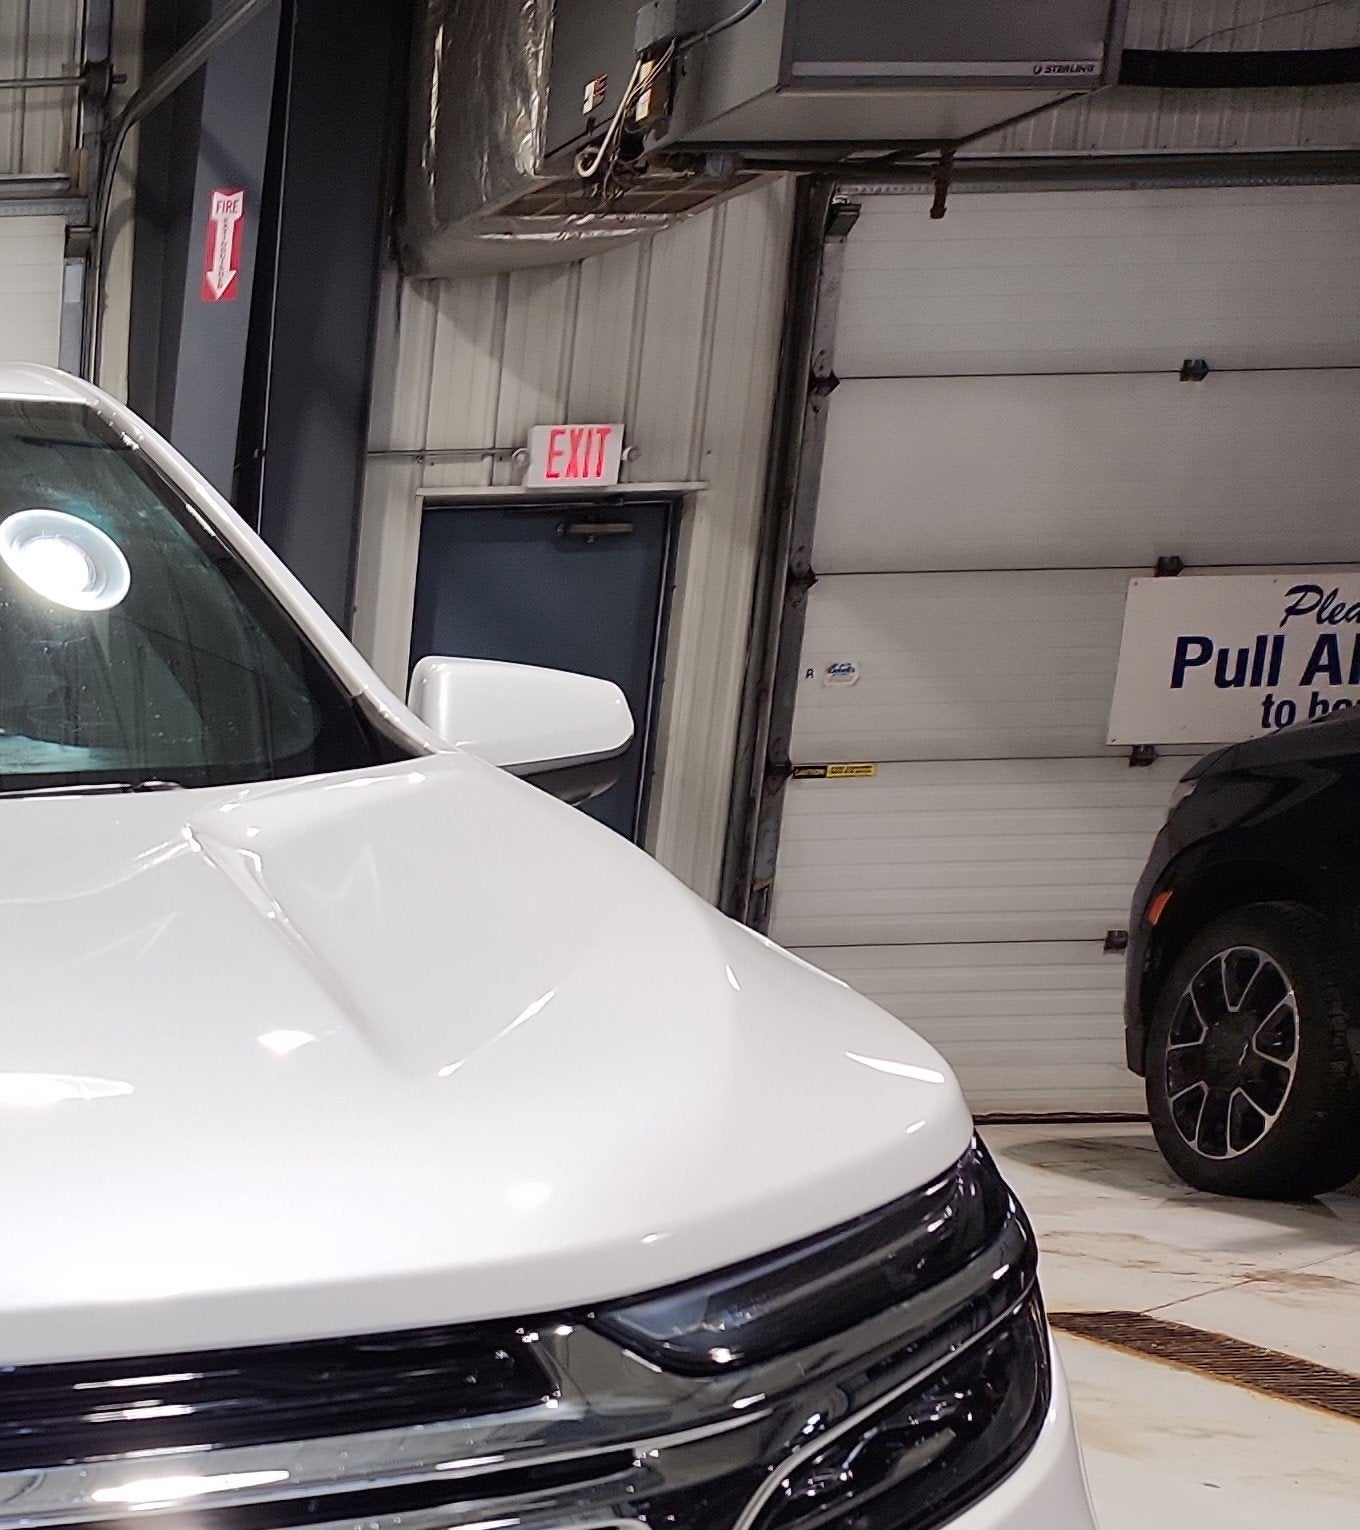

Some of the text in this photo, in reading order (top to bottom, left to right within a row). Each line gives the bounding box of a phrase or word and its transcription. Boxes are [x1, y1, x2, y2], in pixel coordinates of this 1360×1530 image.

[215, 200, 240, 214] FIRE
[545, 427, 612, 479] EXIT
[1170, 633, 1285, 689] Pull
[1261, 693, 1297, 729] to
